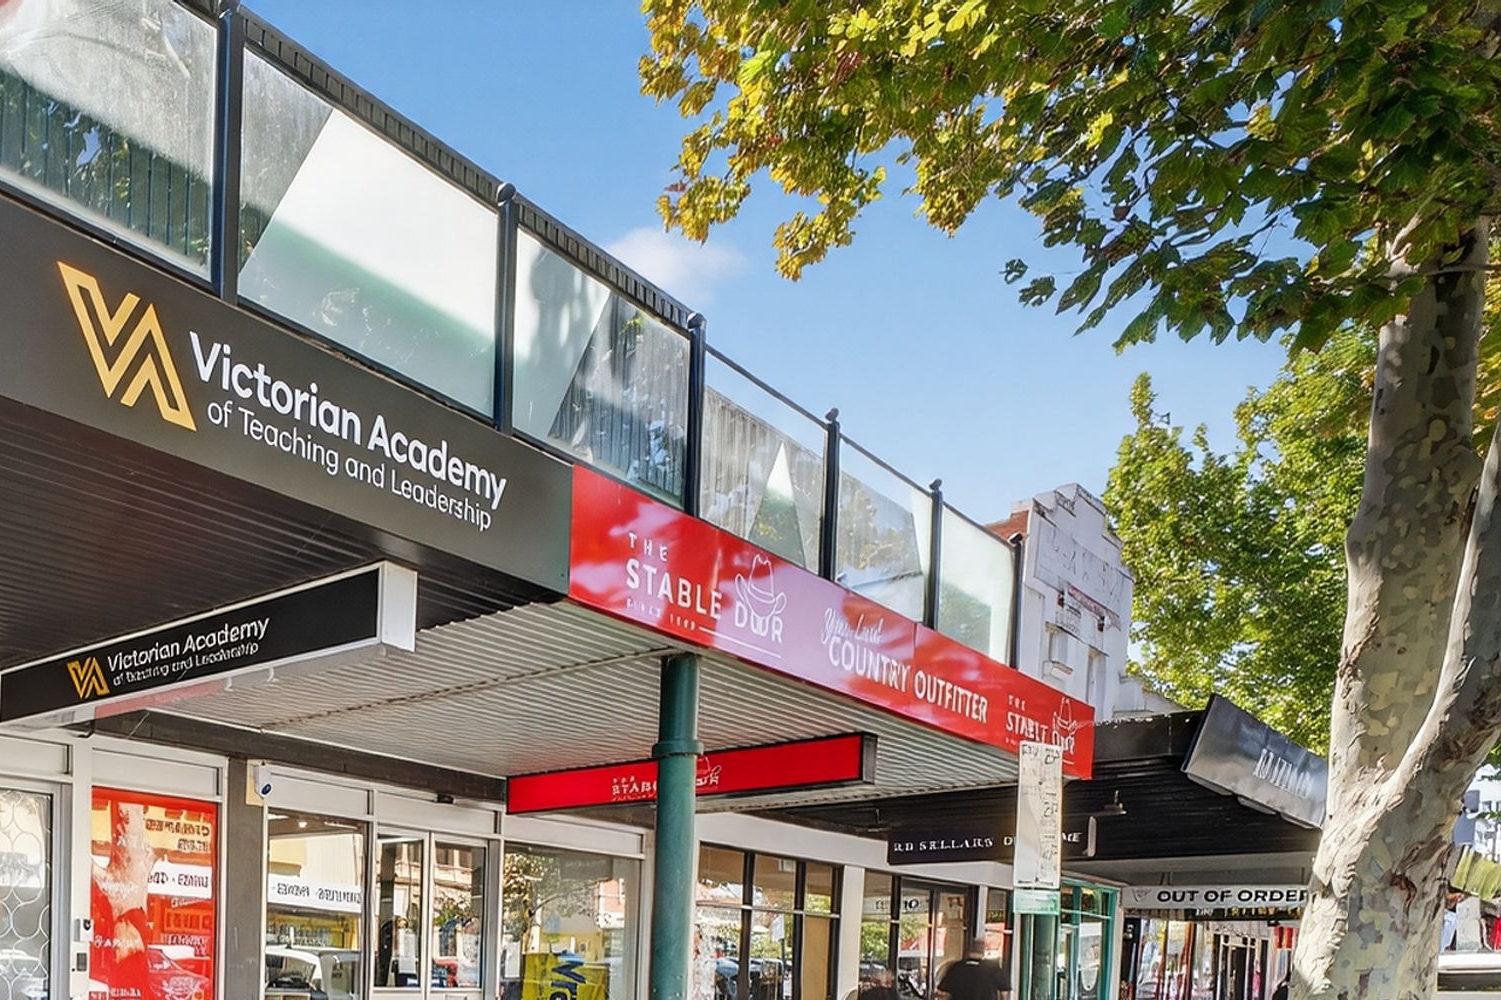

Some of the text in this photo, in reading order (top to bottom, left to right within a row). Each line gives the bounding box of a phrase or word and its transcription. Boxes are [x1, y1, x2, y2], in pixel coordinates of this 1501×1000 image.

[189, 331, 508, 510] Victorian Academy
[206, 398, 493, 532] of Teaching and Leadership
[629, 532, 668, 562] THE
[626, 558, 722, 620] STABLE
[108, 616, 269, 672] Victorian Academy
[828, 636, 989, 724] COUNTRY OUTFITTER
[919, 836, 994, 851] SELLARS
[1157, 890, 1199, 903] OUT
[1204, 890, 1232, 903] OF
